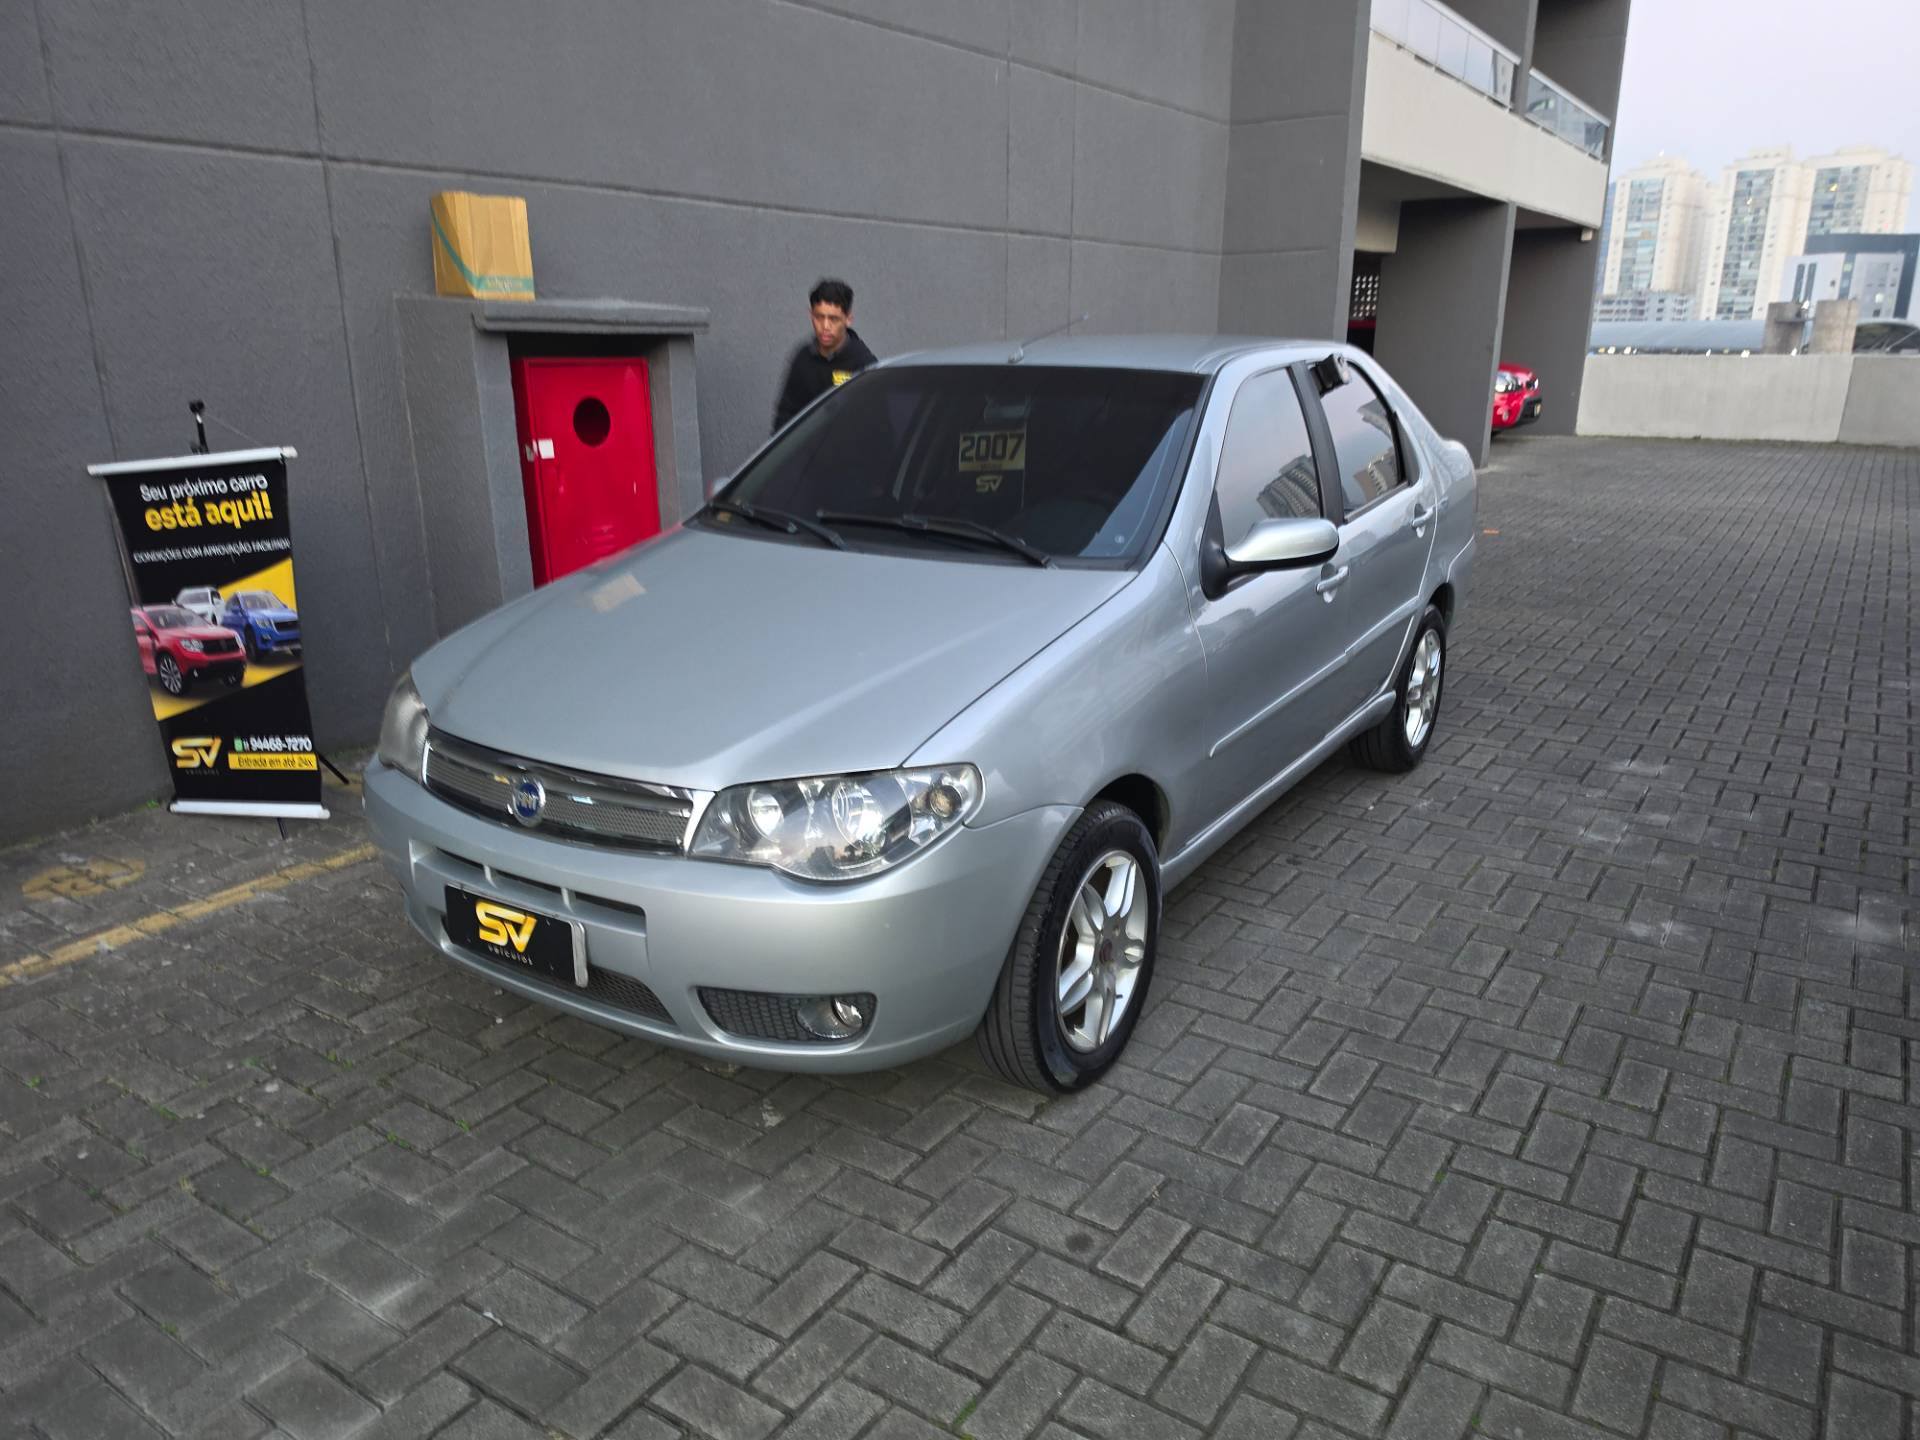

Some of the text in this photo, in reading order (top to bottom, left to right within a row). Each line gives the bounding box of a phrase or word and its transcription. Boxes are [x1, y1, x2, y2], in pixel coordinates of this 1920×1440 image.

[960, 433, 1025, 462] 2007
[140, 474, 269, 502] Seu próximo carro
[145, 490, 272, 532] está aqui!
[171, 736, 222, 769] SV
[238, 756, 267, 768] Entrada
[475, 901, 538, 953] SV
